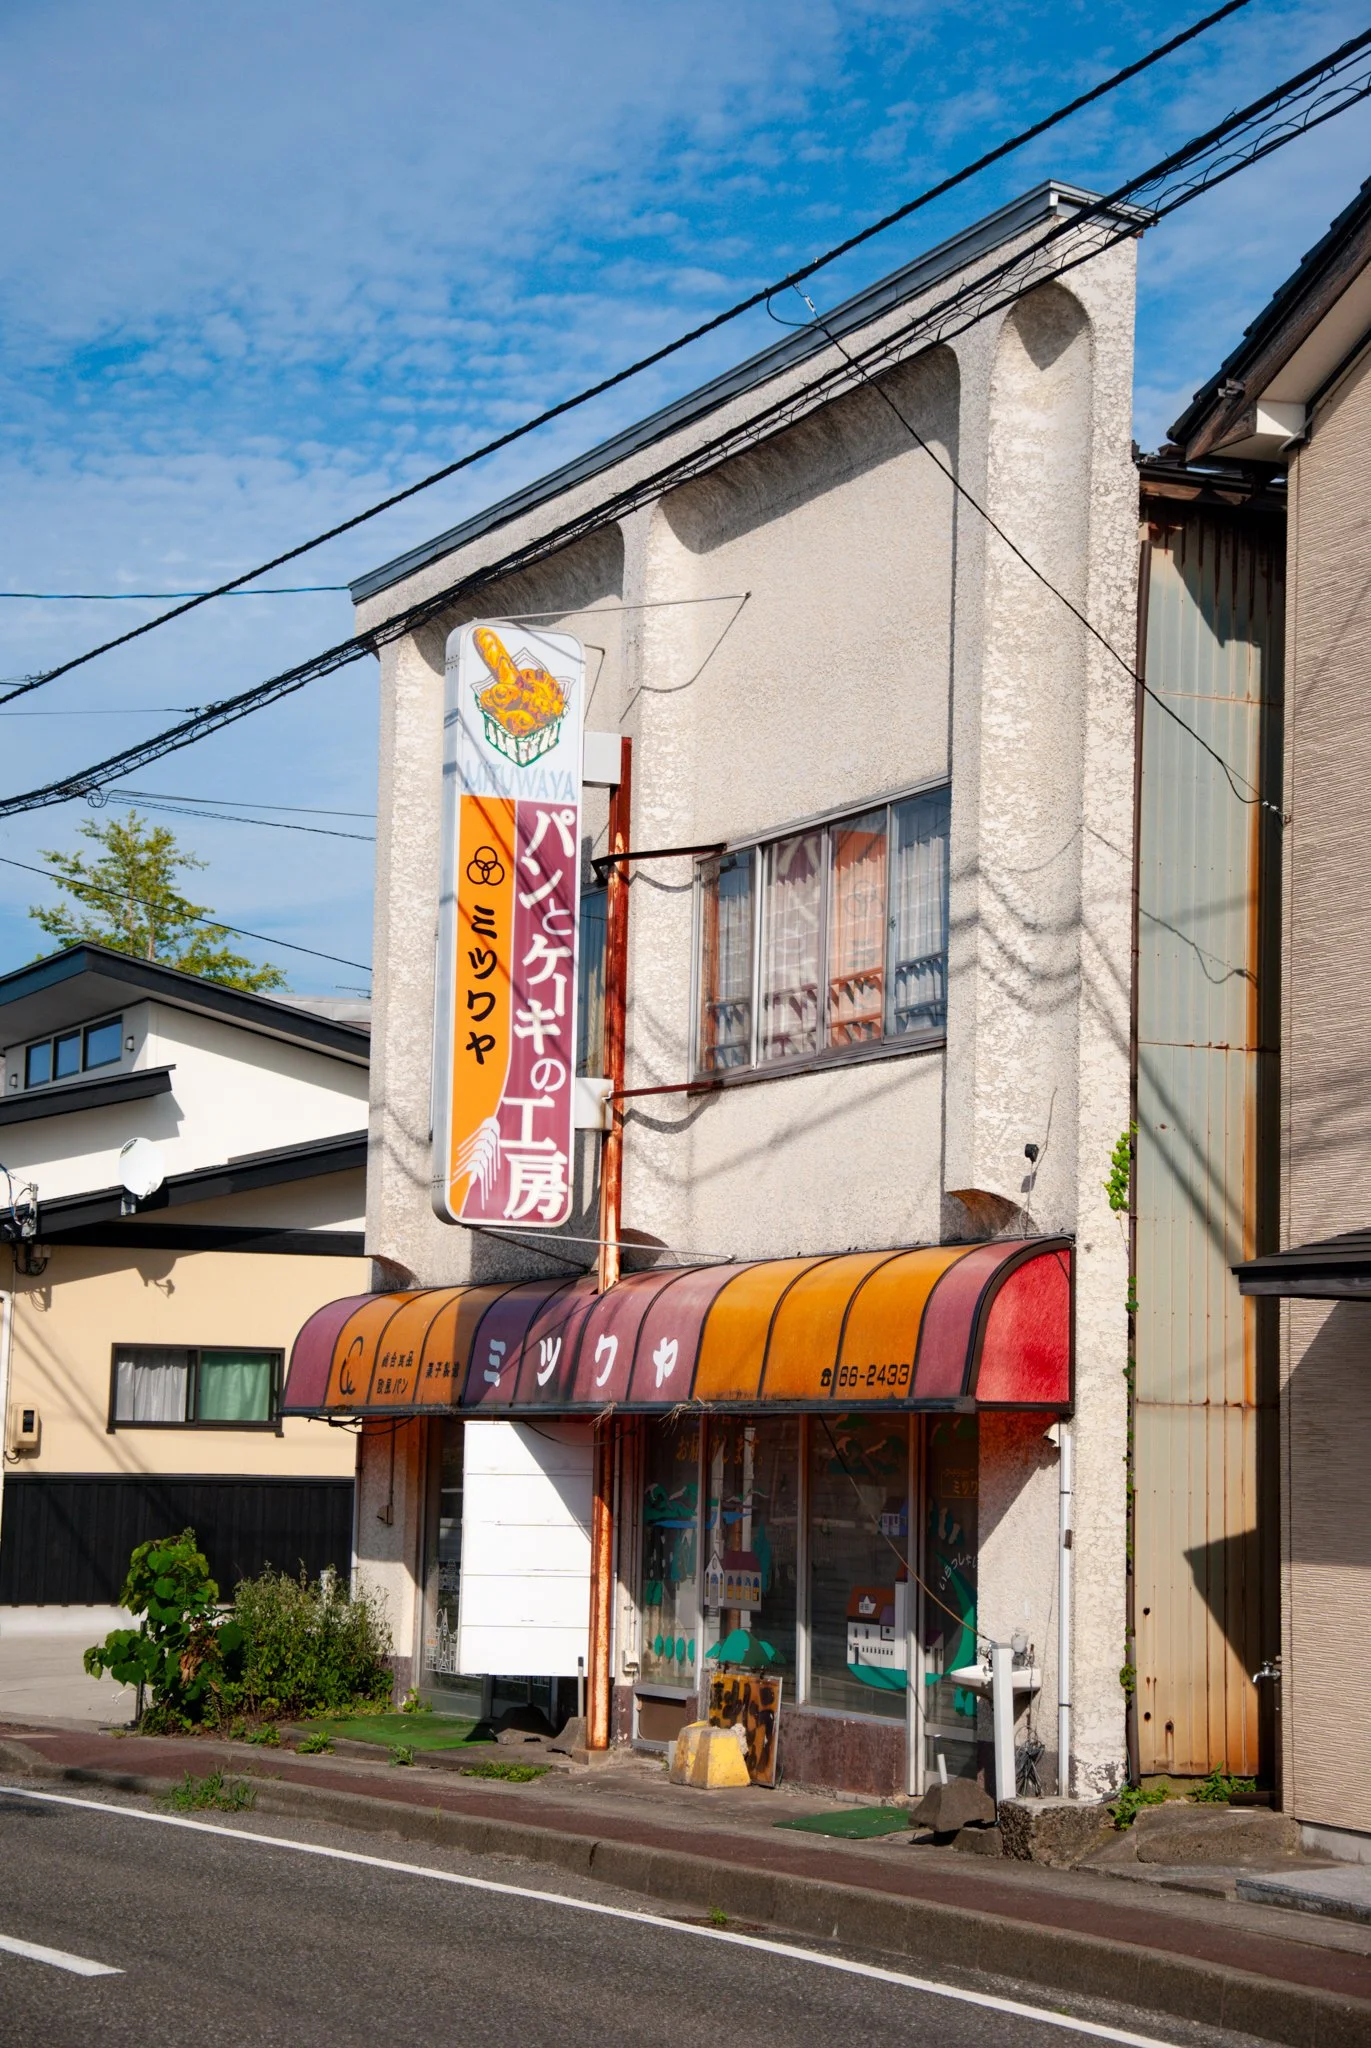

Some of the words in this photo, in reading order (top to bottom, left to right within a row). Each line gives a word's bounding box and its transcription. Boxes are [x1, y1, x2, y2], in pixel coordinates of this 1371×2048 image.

[465, 904, 498, 1065] ミツワヤ
[500, 806, 576, 1220] パンとケーキの工房
